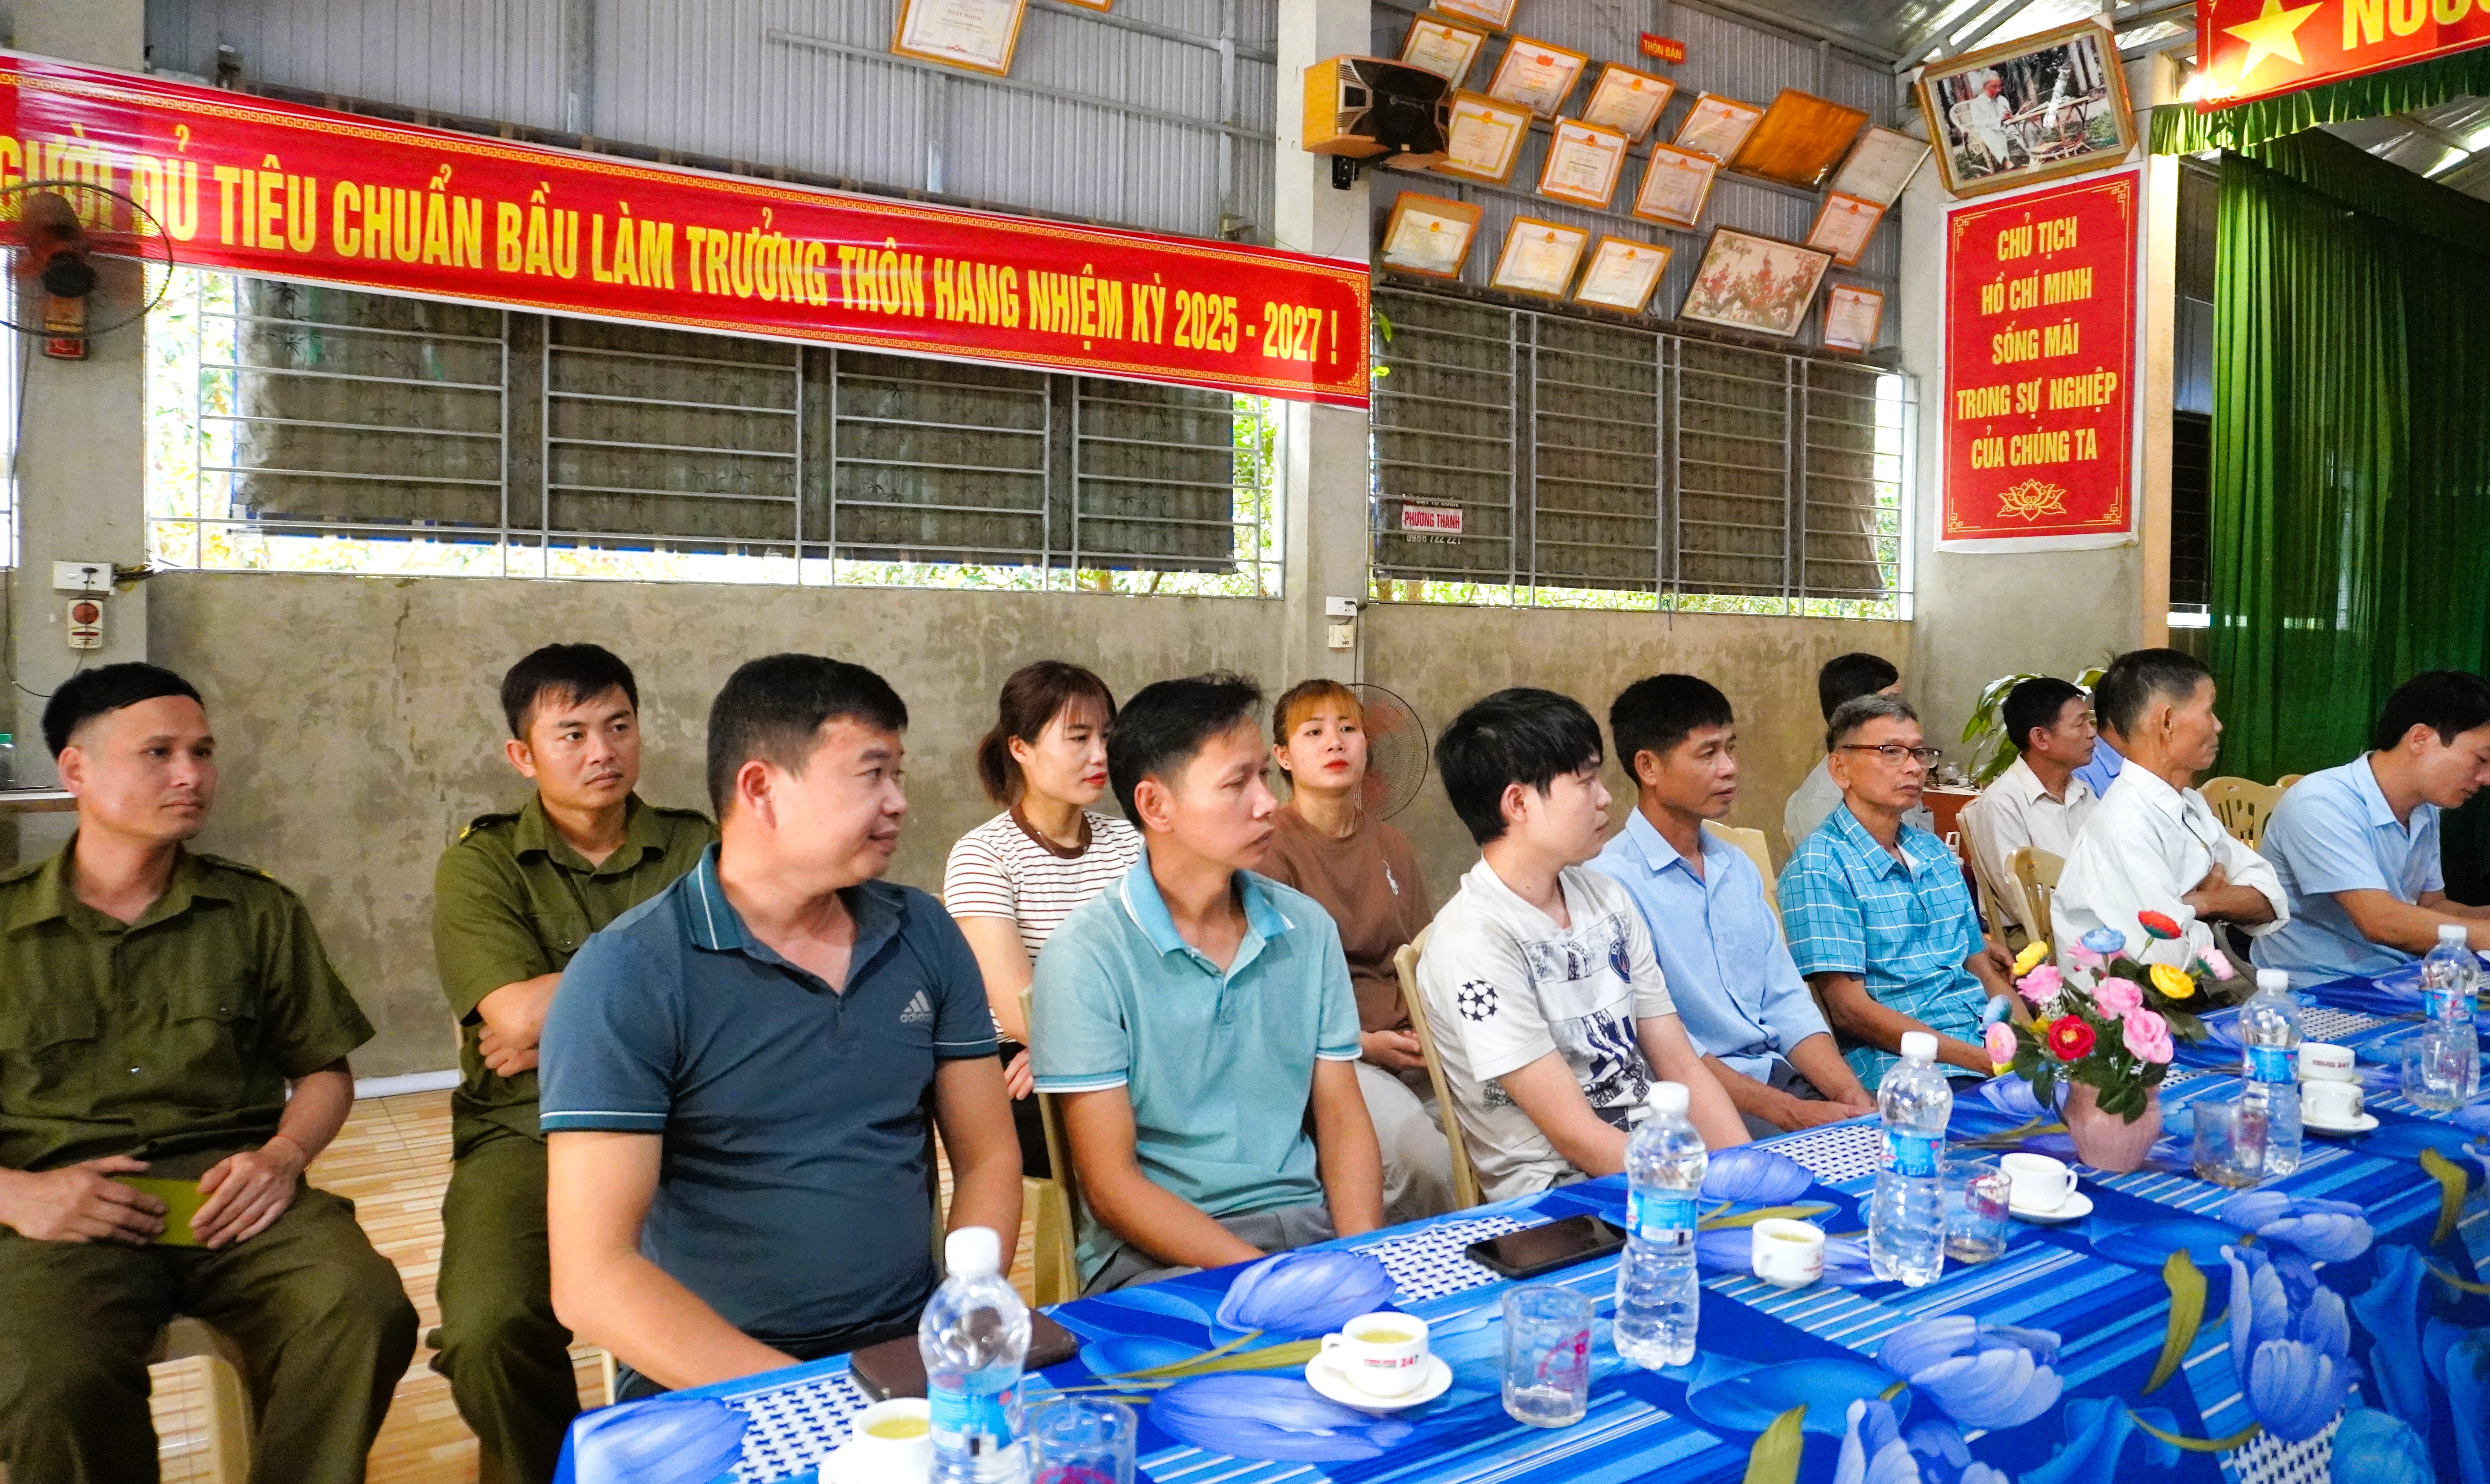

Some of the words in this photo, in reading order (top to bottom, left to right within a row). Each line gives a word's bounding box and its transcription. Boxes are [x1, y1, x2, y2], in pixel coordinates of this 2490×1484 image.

[1643, 40, 1663, 55] THÔN
[1665, 43, 1682, 59] BẢN
[130, 124, 198, 242] ĐỦ
[213, 154, 316, 253] TIÊU
[333, 164, 482, 269] CHUẨN
[497, 180, 579, 279] BẦU
[592, 201, 674, 290] LÀM
[686, 207, 828, 306] TRƯỞNG
[837, 237, 925, 317] THÔN
[933, 257, 1020, 328] HANG
[1028, 265, 1124, 350] NHIỆM
[1131, 272, 1167, 345] KỲ
[1174, 289, 1238, 353] 2025
[1246, 324, 1256, 337] -
[1262, 301, 1322, 362] 2027
[1330, 310, 1338, 364] !
[1998, 212, 2033, 262] CHỦ
[2037, 216, 2077, 263] TỊCH
[1982, 271, 2005, 315] HỒ
[2009, 269, 2039, 311] CHÍ
[2043, 267, 2092, 305] MINH
[1992, 320, 2039, 365] SỐNG
[2044, 317, 2079, 358] MÃI
[1957, 384, 2011, 420] TRONG
[2016, 377, 2042, 419] SỰ
[2049, 366, 2117, 414] NGHIỆP
[1971, 426, 2005, 470] CỦA
[2010, 427, 2070, 467] CHÚNG
[2075, 427, 2097, 461] TA
[1404, 510, 1435, 528] PHƯƠNG
[1436, 513, 1460, 530] THANH
